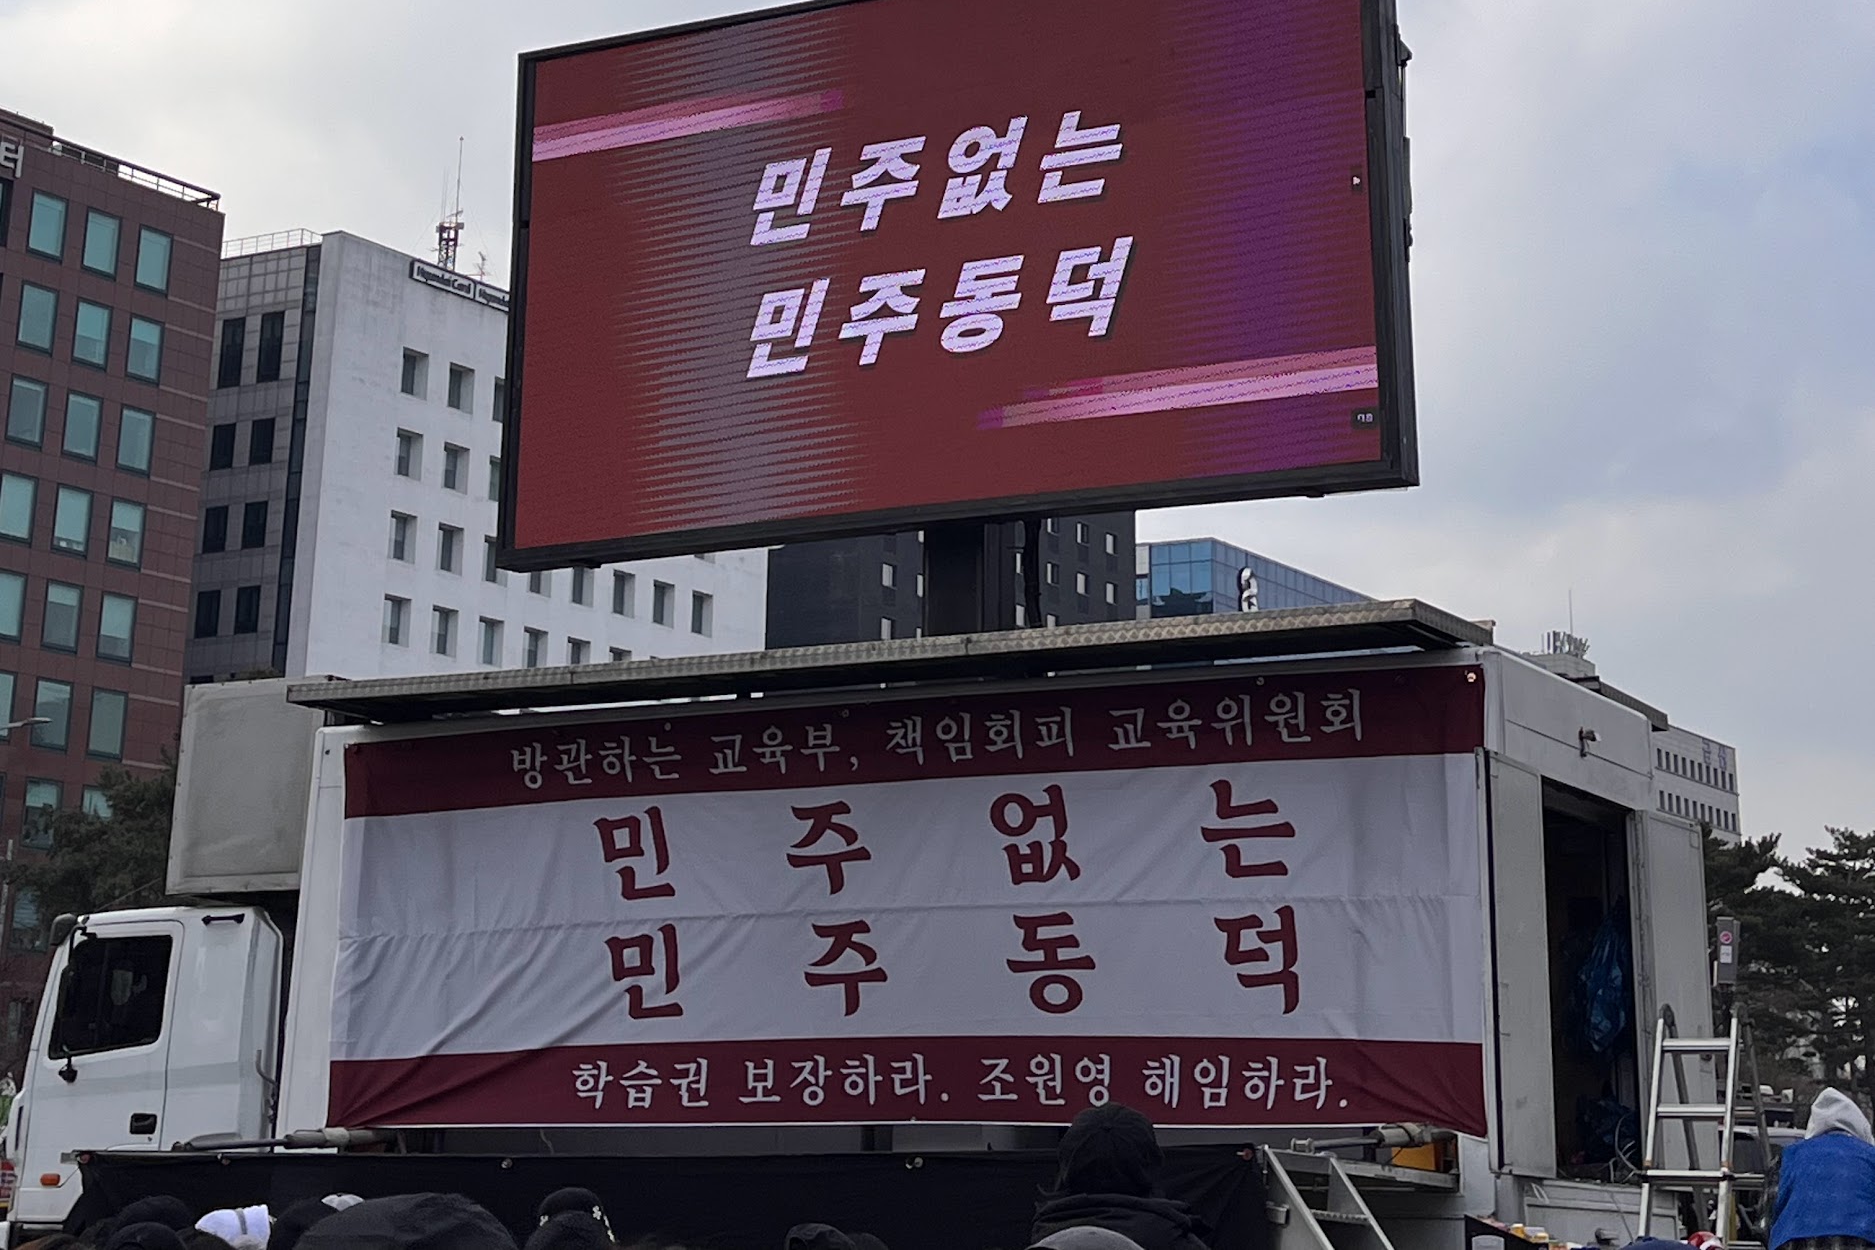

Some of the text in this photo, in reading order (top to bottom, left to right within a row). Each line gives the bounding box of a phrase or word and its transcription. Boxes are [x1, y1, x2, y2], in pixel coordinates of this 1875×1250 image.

[511, 688, 1363, 790] 방관하는 교육부, 책임회피 교육위원회
[571, 1052, 1349, 1110] 학습권 보장하라. 조원영 해임하라.
